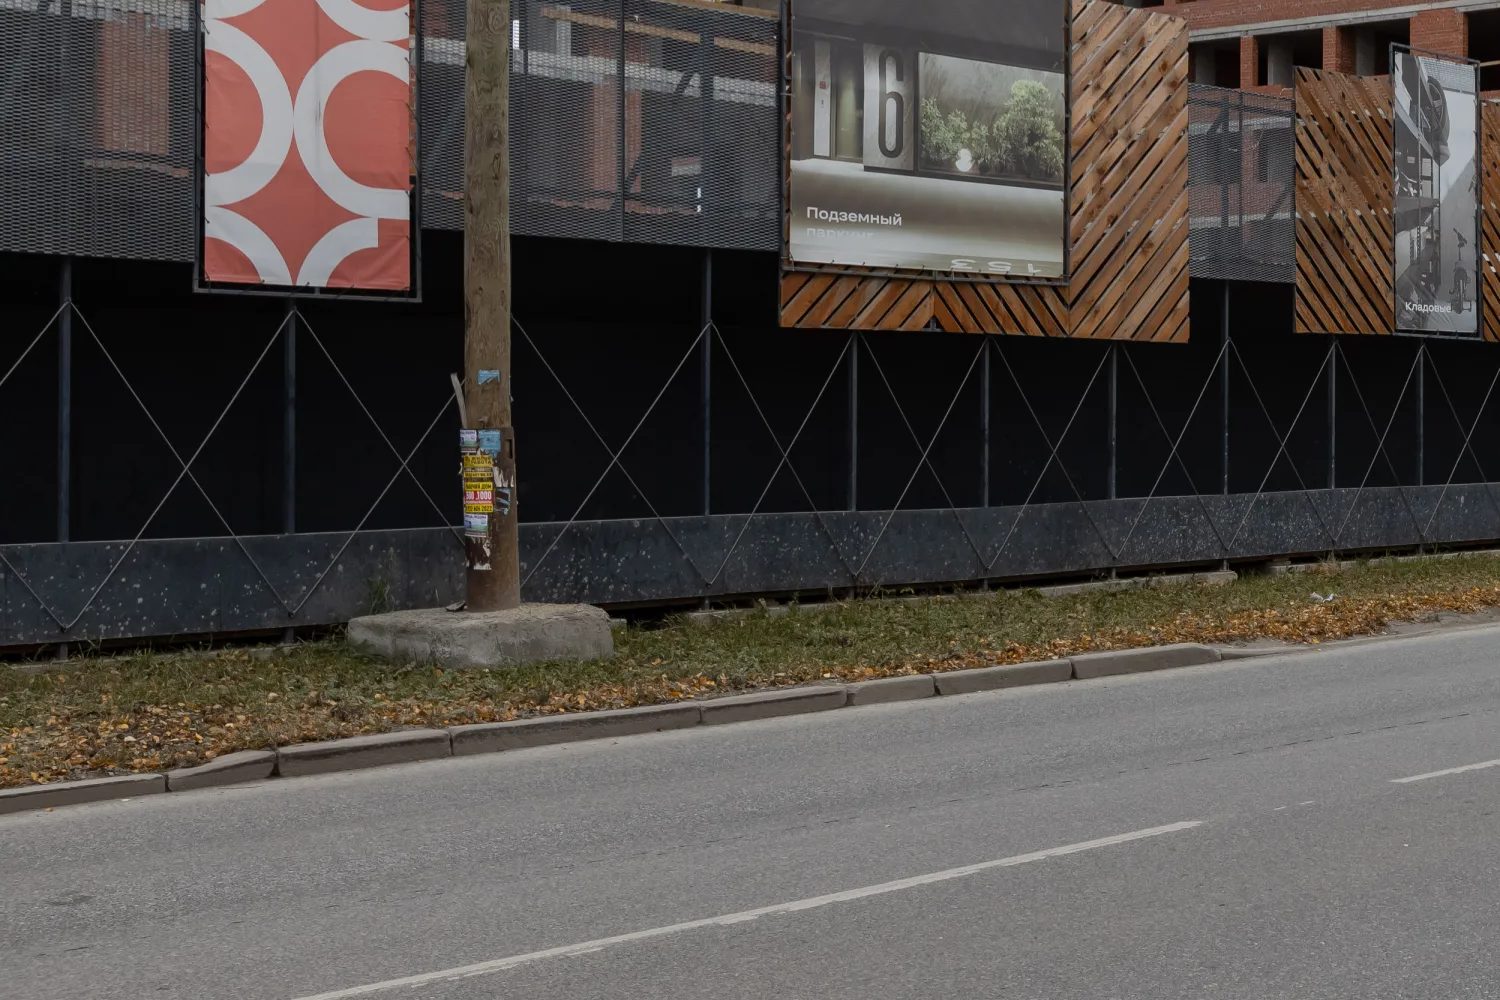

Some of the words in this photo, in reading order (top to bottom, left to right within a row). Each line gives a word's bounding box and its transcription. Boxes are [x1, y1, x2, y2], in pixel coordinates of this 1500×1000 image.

[878, 48, 904, 159] 6
[806, 206, 902, 227] Подземный
[1405, 301, 1452, 314] Кладовые
